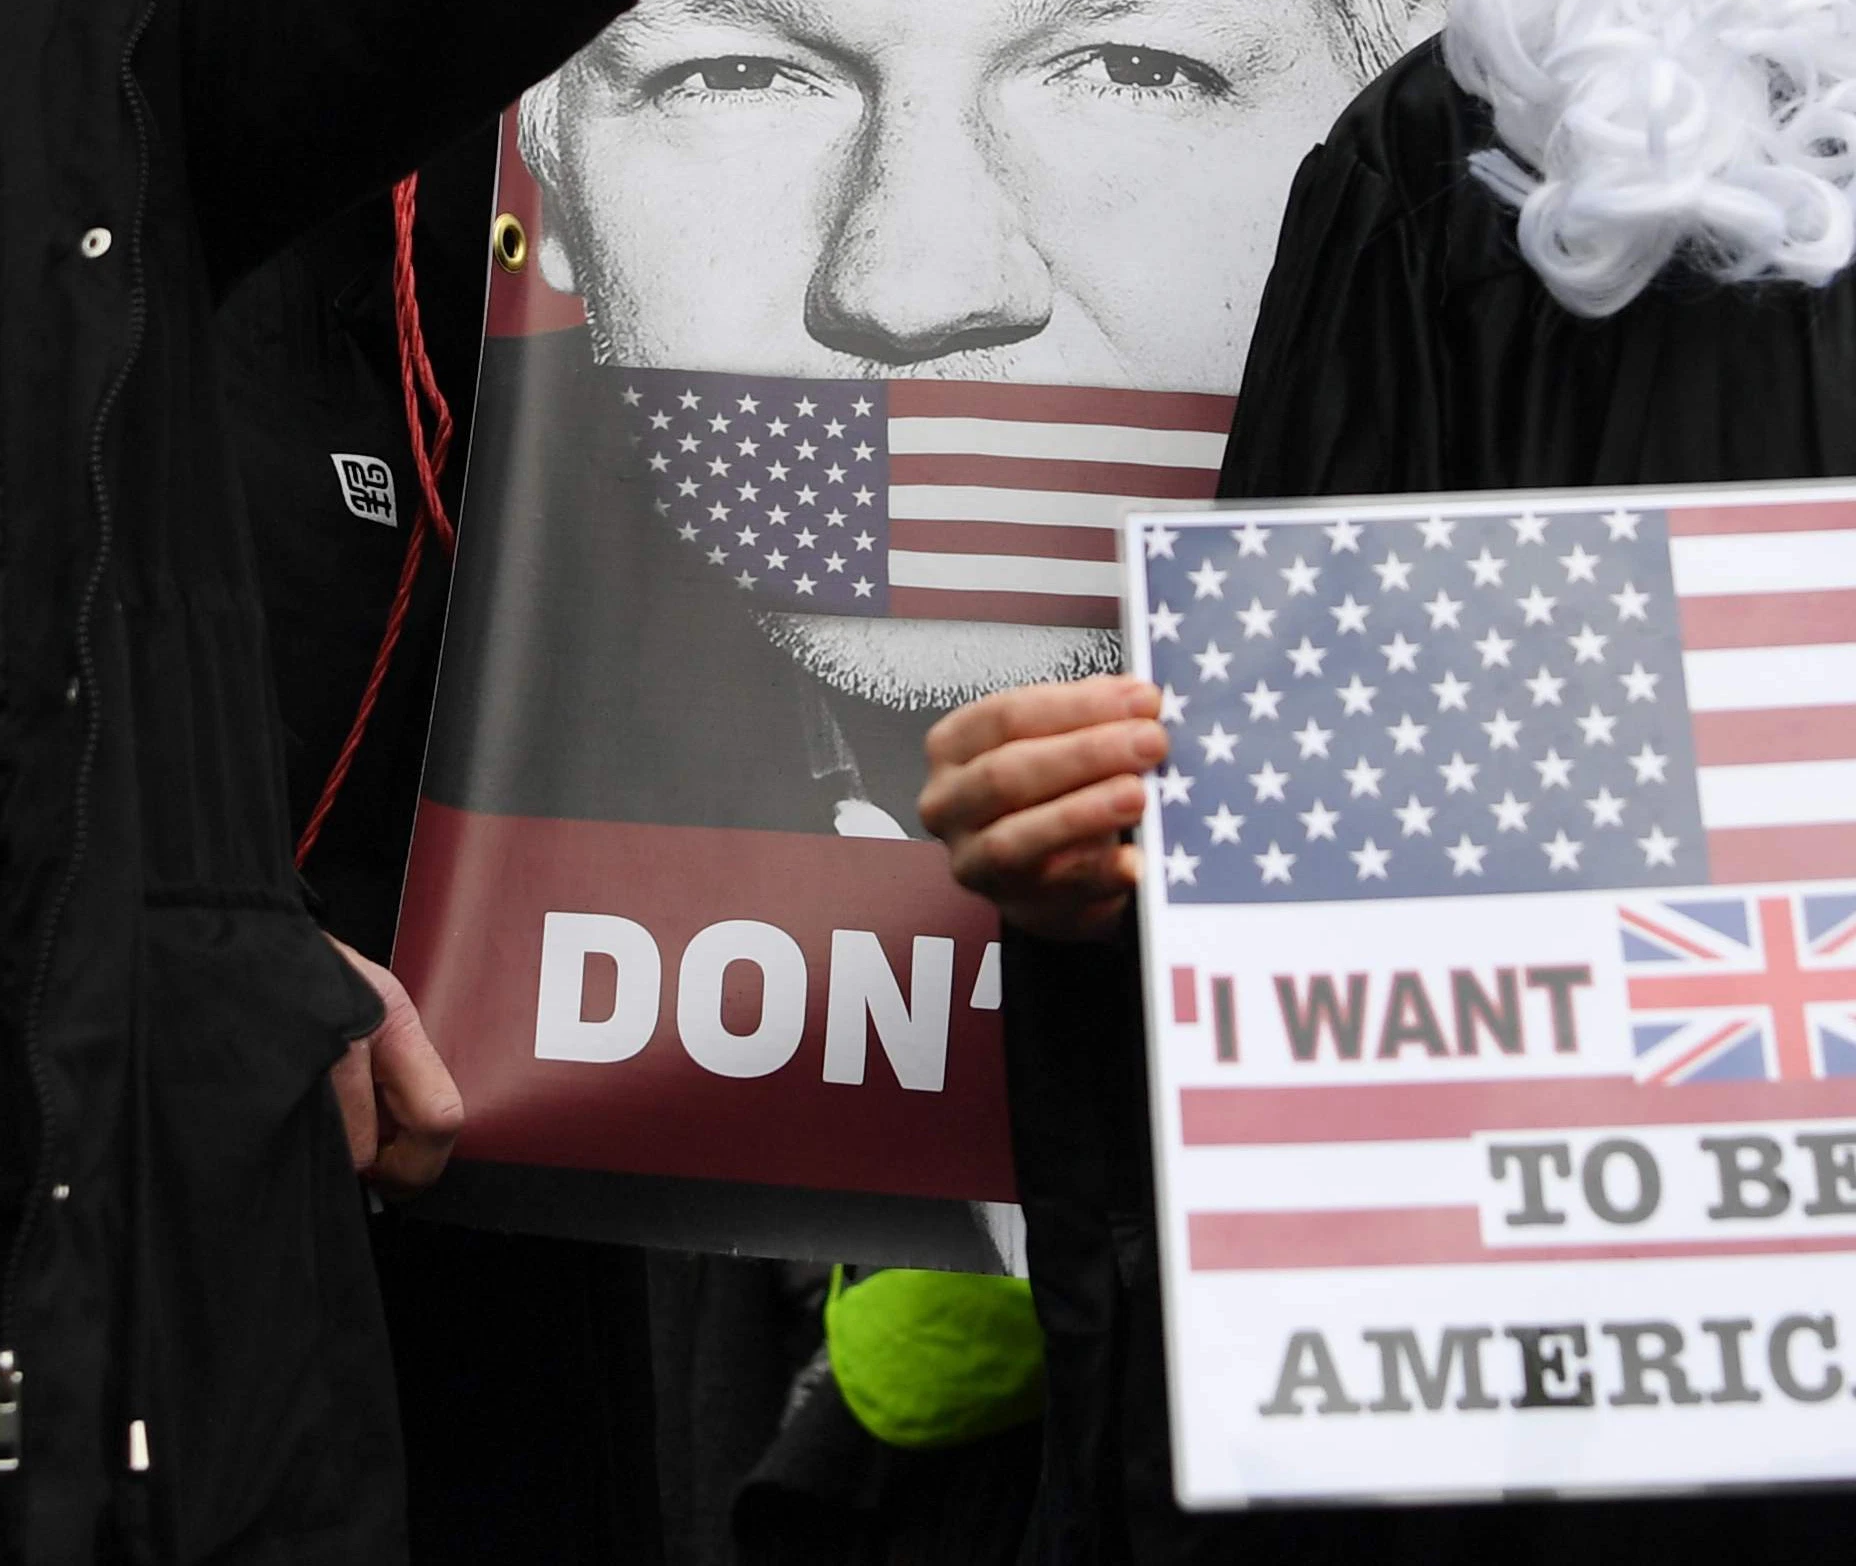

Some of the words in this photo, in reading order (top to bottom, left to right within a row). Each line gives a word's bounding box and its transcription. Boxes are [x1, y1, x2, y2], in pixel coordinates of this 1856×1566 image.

[1210, 974, 1241, 1065] I
[1272, 961, 1594, 1063] WANT
[1486, 1138, 1661, 1230] TO
